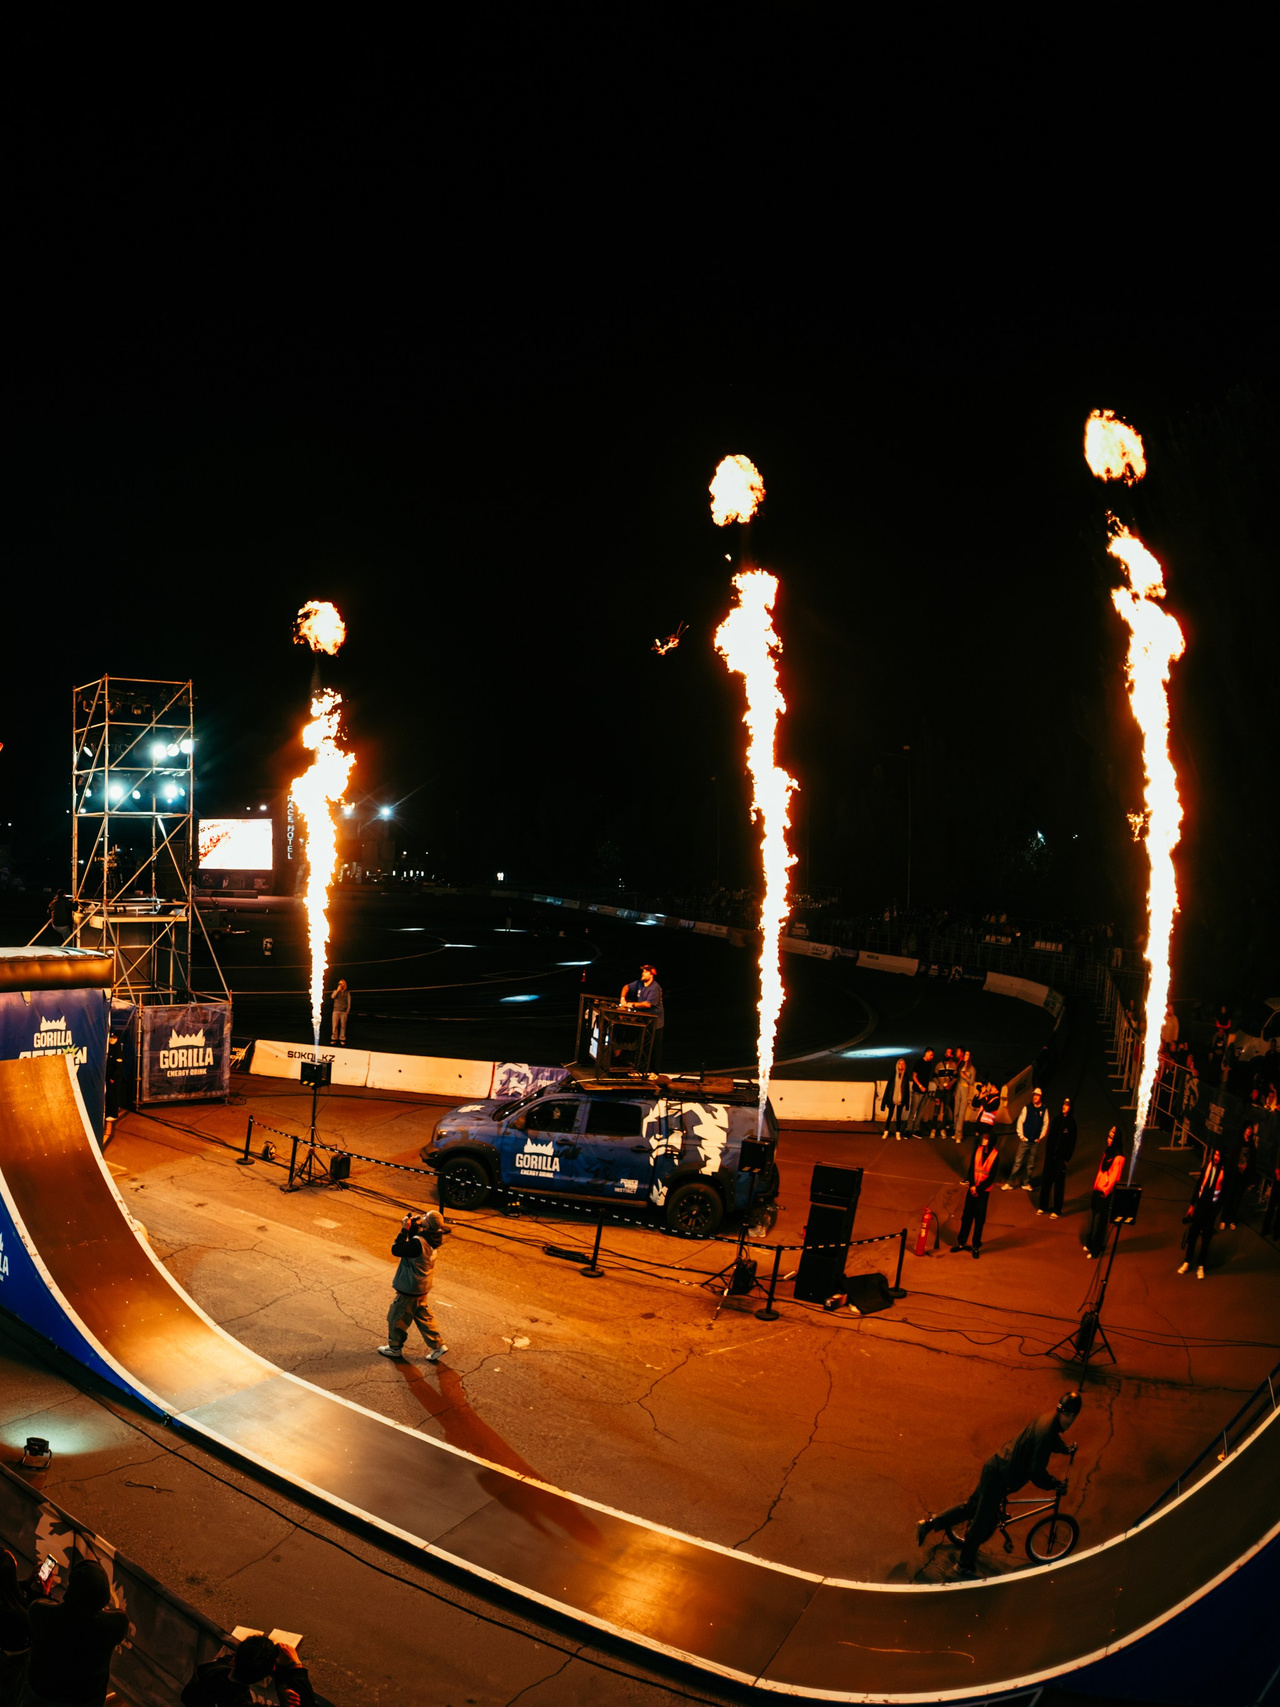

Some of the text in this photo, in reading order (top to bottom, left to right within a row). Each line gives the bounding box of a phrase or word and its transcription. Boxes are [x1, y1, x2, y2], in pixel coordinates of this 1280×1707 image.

[34, 1030, 73, 1048] GORILLA
[160, 1047, 214, 1069] GORILLA
[167, 1068, 208, 1078] ENERGY DRINK
[515, 1153, 560, 1172] GORILLA
